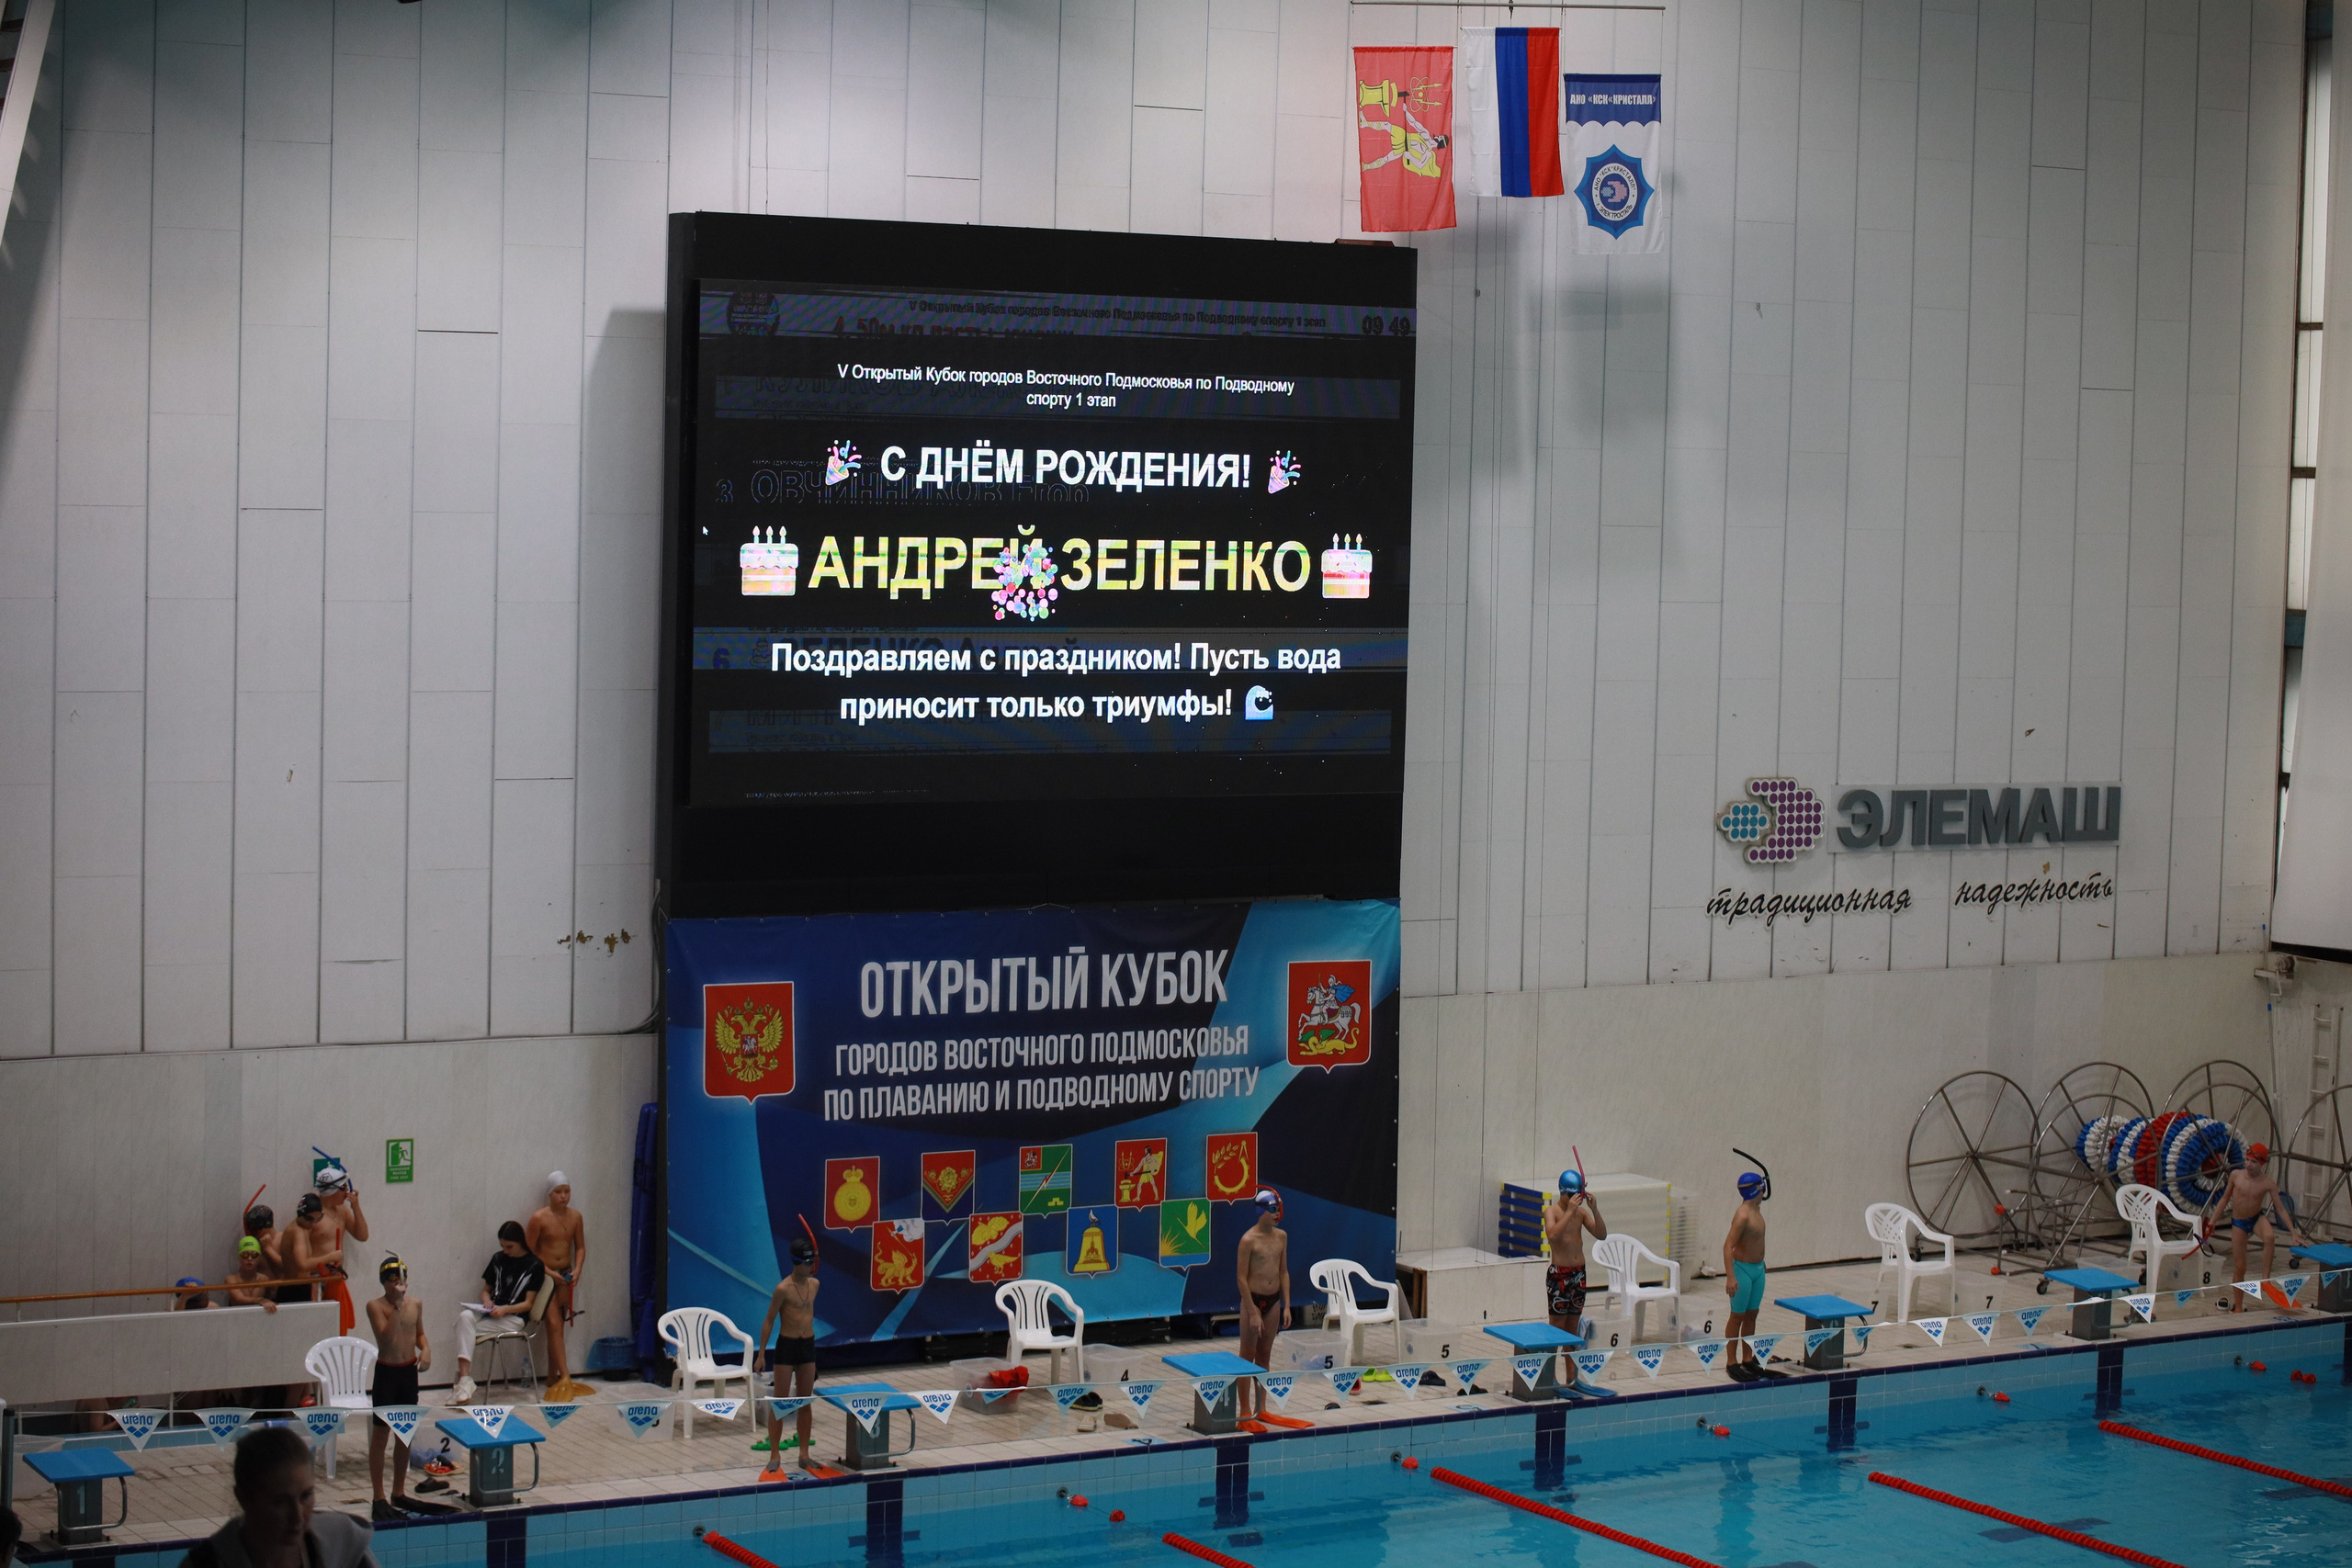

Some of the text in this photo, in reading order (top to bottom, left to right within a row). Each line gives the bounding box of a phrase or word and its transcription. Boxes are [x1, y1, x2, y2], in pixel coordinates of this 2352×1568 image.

[1569, 94, 1586, 105] АНО
[837, 364, 848, 378] V
[852, 364, 922, 384] Открытый
[926, 367, 966, 386] Кубок
[969, 370, 1023, 386] городов
[1026, 369, 1102, 387] Восточного
[1106, 373, 1193, 389] Подмосковья
[1196, 378, 1212, 391] по
[1216, 376, 1295, 396] Подводному
[1026, 391, 1116, 410] спорту 1 этап
[880, 439, 1250, 492] С ДНЁМ РОЖДЕНИЯ!
[808, 525, 1310, 600] АНДРЕЙ ЗЕЛЕНКО
[771, 643, 972, 678] Поздравляем
[979, 650, 995, 671] с
[1004, 643, 1182, 677] праздником!
[1191, 643, 1270, 676] Пусть
[1277, 649, 1341, 673] вода
[840, 695, 979, 726] приносит
[987, 694, 1085, 718] только
[1093, 690, 1233, 723] триумфы!
[1837, 786, 2121, 849] ЭЛЕМАШ
[1706, 872, 2113, 927] традиционная надежность
[860, 946, 1229, 1019] ОТКРЫТЫЙ КУБОК
[836, 1025, 1249, 1077] ГОРОДОВ ВОСТОЧНОГО ПОДМОСКОВЬЯ
[824, 1066, 1260, 1122] ПО ПЛАВАНИЮ И ПОДВОДНОМУ СПОРТУ
[2203, 1271, 2211, 1284] 8
[2284, 1279, 2304, 1288] arena
[1986, 1296, 1994, 1308] 7
[1972, 1314, 1992, 1325] arena
[2021, 1310, 2041, 1319] arena
[1703, 1319, 1712, 1334] 6
[1611, 1334, 1619, 1347] 6
[1753, 1339, 1774, 1348] arena
[1441, 1345, 1450, 1358] 5
[1637, 1348, 1661, 1359] arena
[1698, 1345, 1719, 1354] arena
[1325, 1356, 1333, 1369] 5
[1517, 1359, 1541, 1369] arena
[1578, 1354, 1604, 1363] arena
[1395, 1369, 1420, 1378] arena
[1456, 1363, 1480, 1373] arena
[1121, 1370, 1129, 1381] 4
[1266, 1376, 1293, 1386] arena
[1333, 1372, 1357, 1382] arena
[1128, 1384, 1154, 1395] arena
[1200, 1381, 1225, 1391] arena
[922, 1393, 952, 1403] arena
[1057, 1387, 1084, 1398] arena
[852, 1398, 879, 1408] arena
[628, 1405, 658, 1416] arena
[122, 1415, 153, 1426] arena
[209, 1413, 240, 1425] arena
[307, 1413, 339, 1424] arena
[388, 1411, 417, 1422] arena
[440, 1437, 451, 1452] 2
[492, 1448, 505, 1474] 2
[77, 1485, 85, 1514] 1
